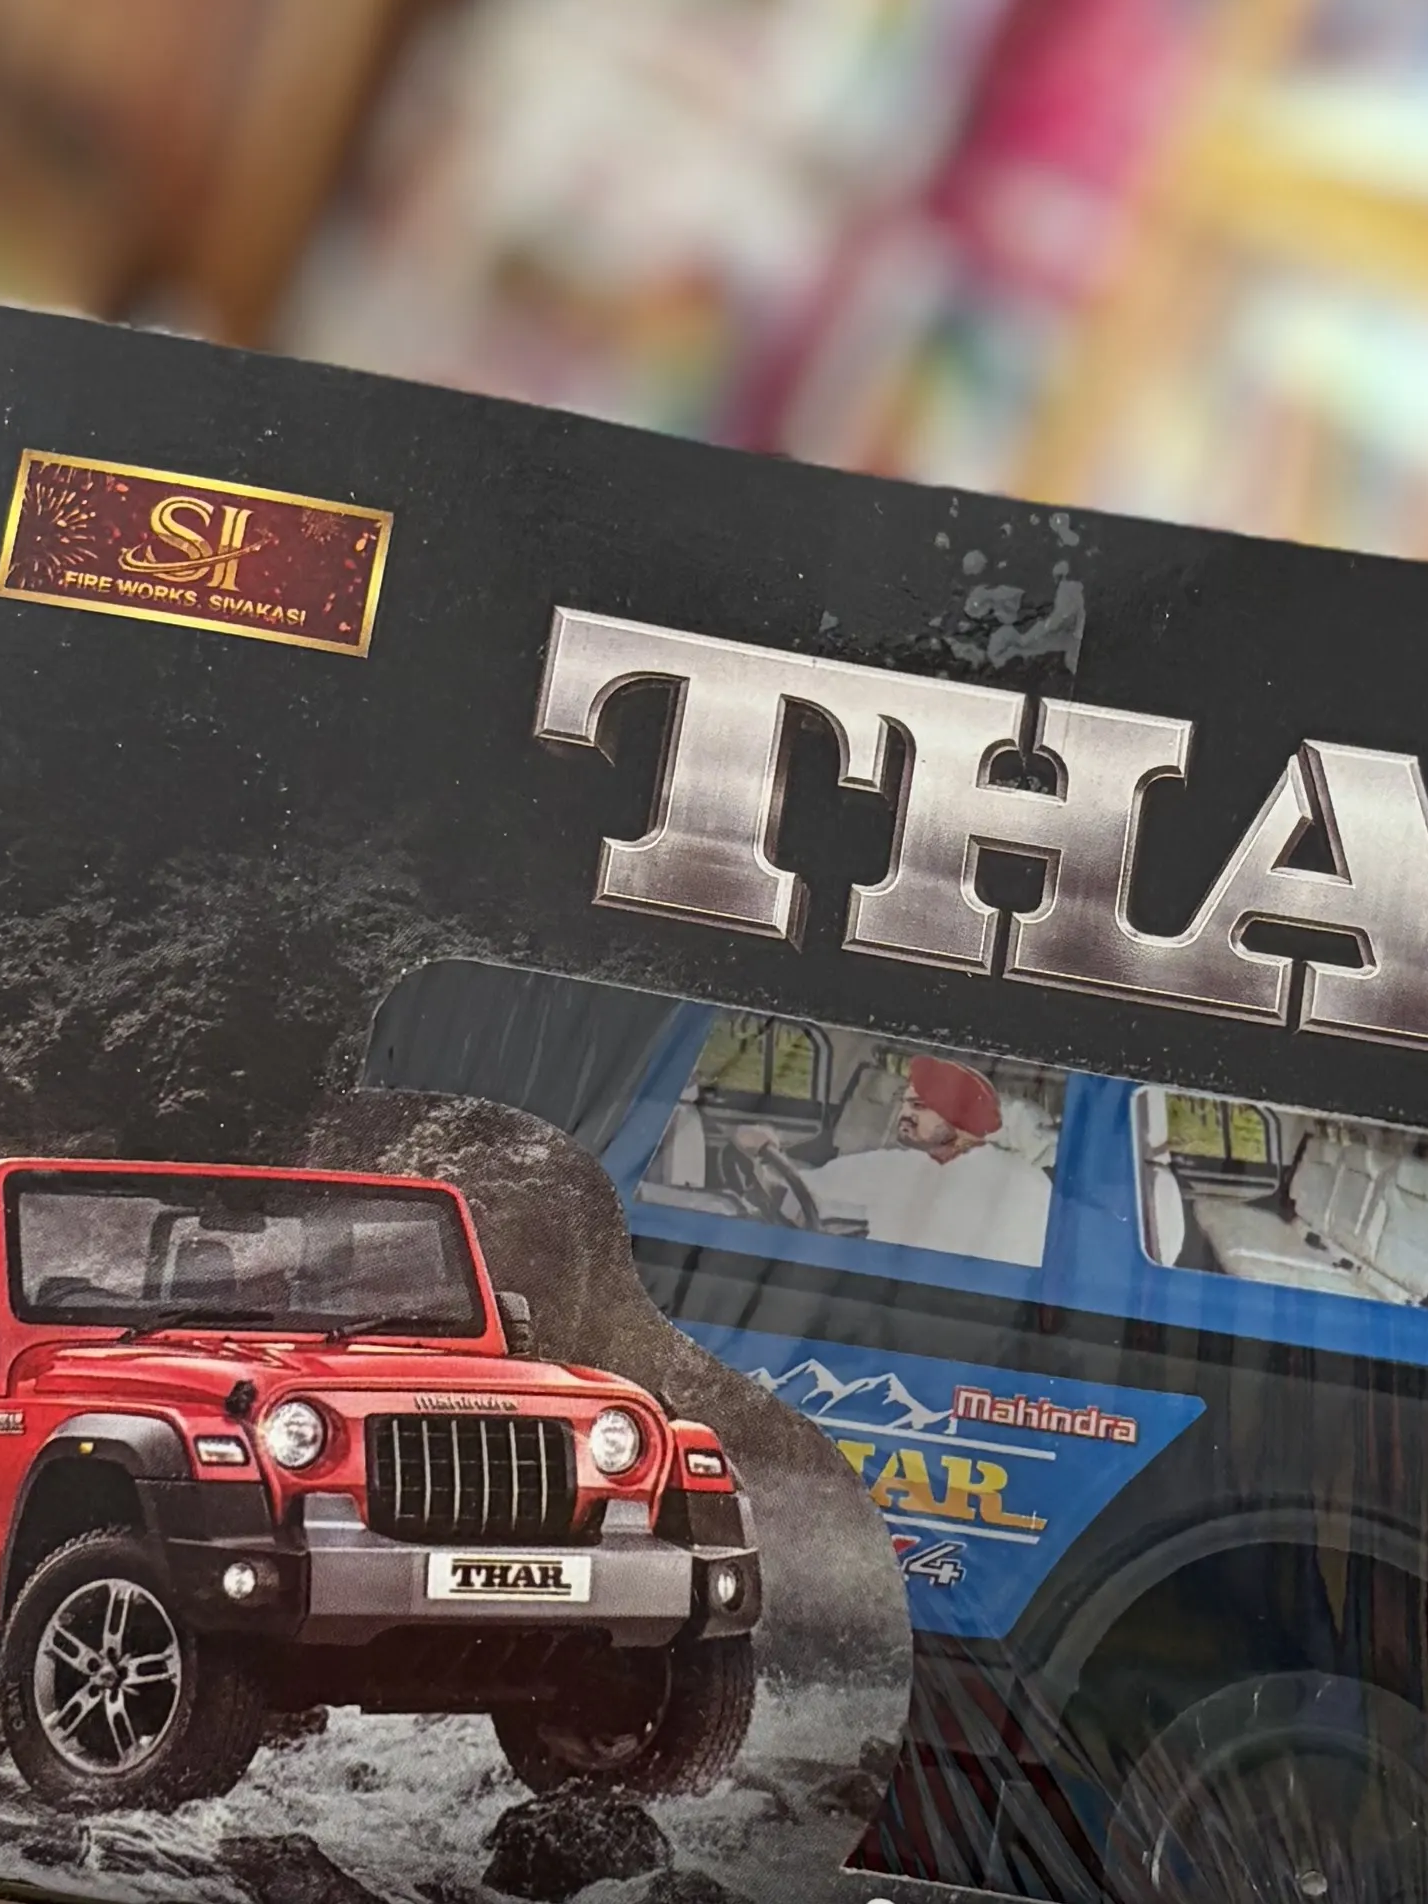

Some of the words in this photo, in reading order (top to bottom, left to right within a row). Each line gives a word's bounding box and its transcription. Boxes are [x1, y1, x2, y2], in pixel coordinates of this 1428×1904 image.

[150, 496, 253, 591] SI
[63, 570, 113, 593] FIRE
[209, 594, 306, 627] SIVAKASI
[451, 1564, 572, 1589] THAR
